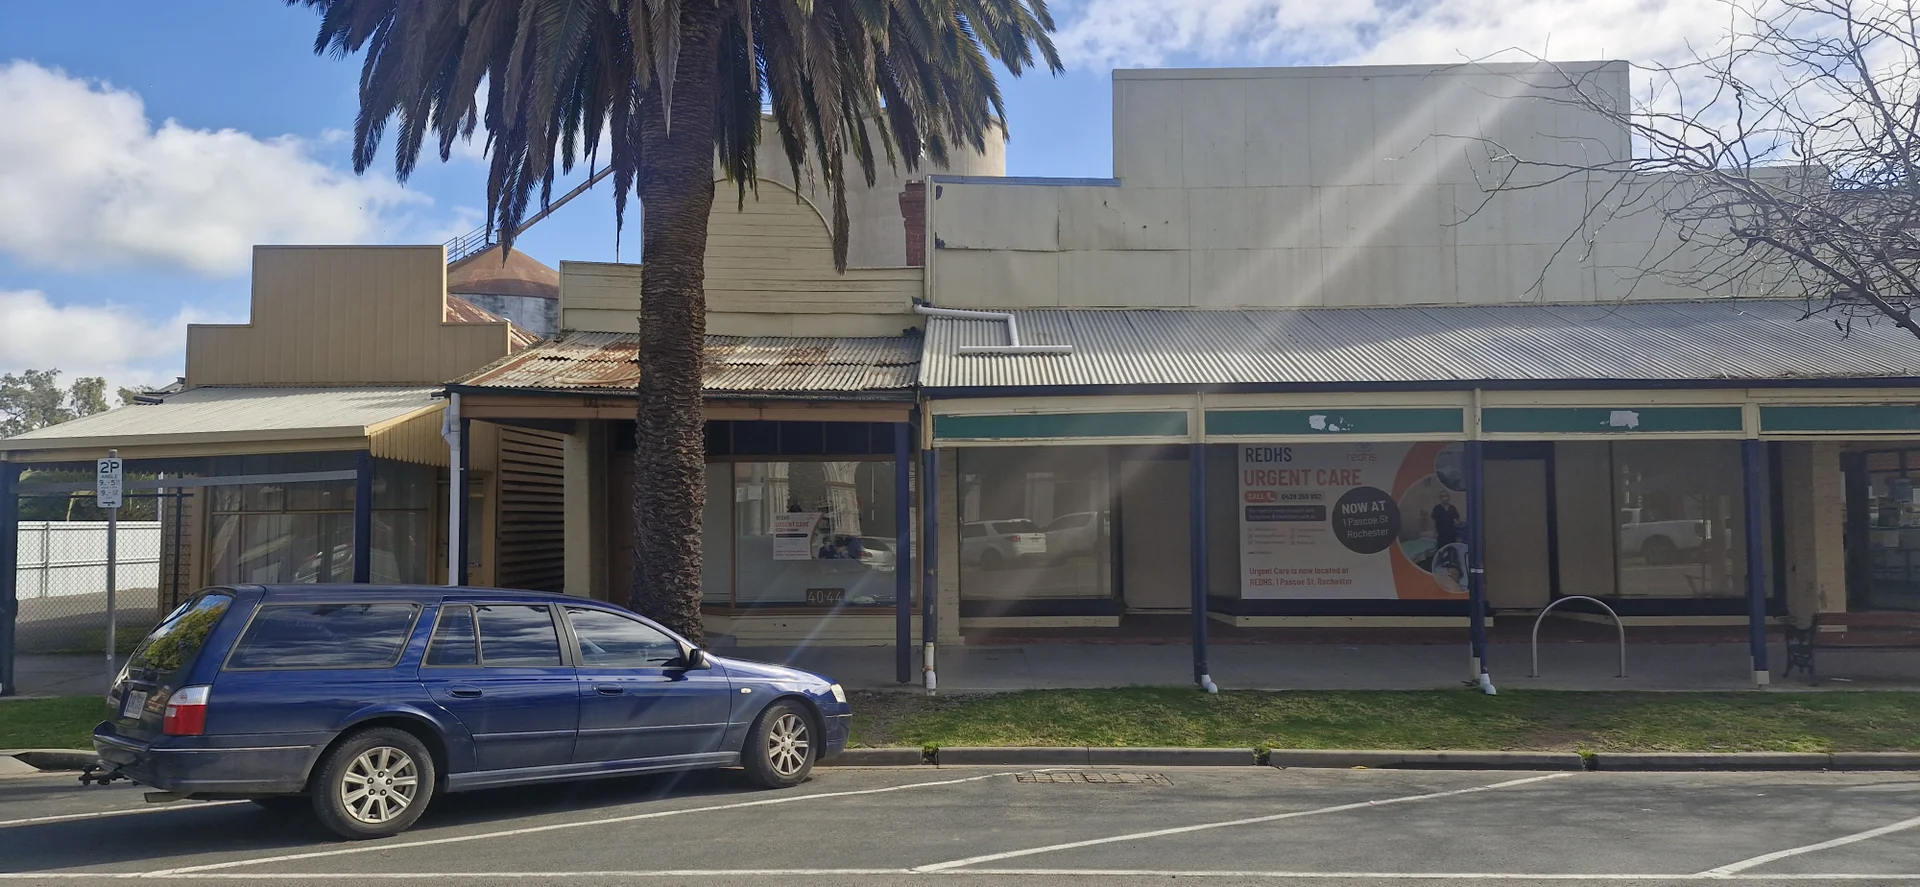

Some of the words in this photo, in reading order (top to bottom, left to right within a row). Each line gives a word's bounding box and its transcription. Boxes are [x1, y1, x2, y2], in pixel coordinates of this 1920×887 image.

[1245, 447, 1293, 463] REDHS
[1346, 452, 1378, 462] redhs
[100, 461, 120, 473] 2P
[1243, 469, 1312, 487] URGENT
[1316, 469, 1363, 486] CARE
[1248, 492, 1264, 500] CALL
[1341, 502, 1368, 515] NOW
[1371, 500, 1386, 512] AT
[1343, 518, 1347, 527] 1
[1348, 517, 1378, 527] Pascoe
[1380, 515, 1389, 524] St
[1347, 528, 1390, 539] Rochester
[1249, 567, 1273, 577] Urgent
[1273, 567, 1290, 575] Care
[1290, 567, 1297, 575] is
[1314, 566, 1341, 574] located
[1249, 578, 1275, 587] REDHS,
[1280, 578, 1306, 586] Pascoe
[1317, 577, 1353, 586] Rochester
